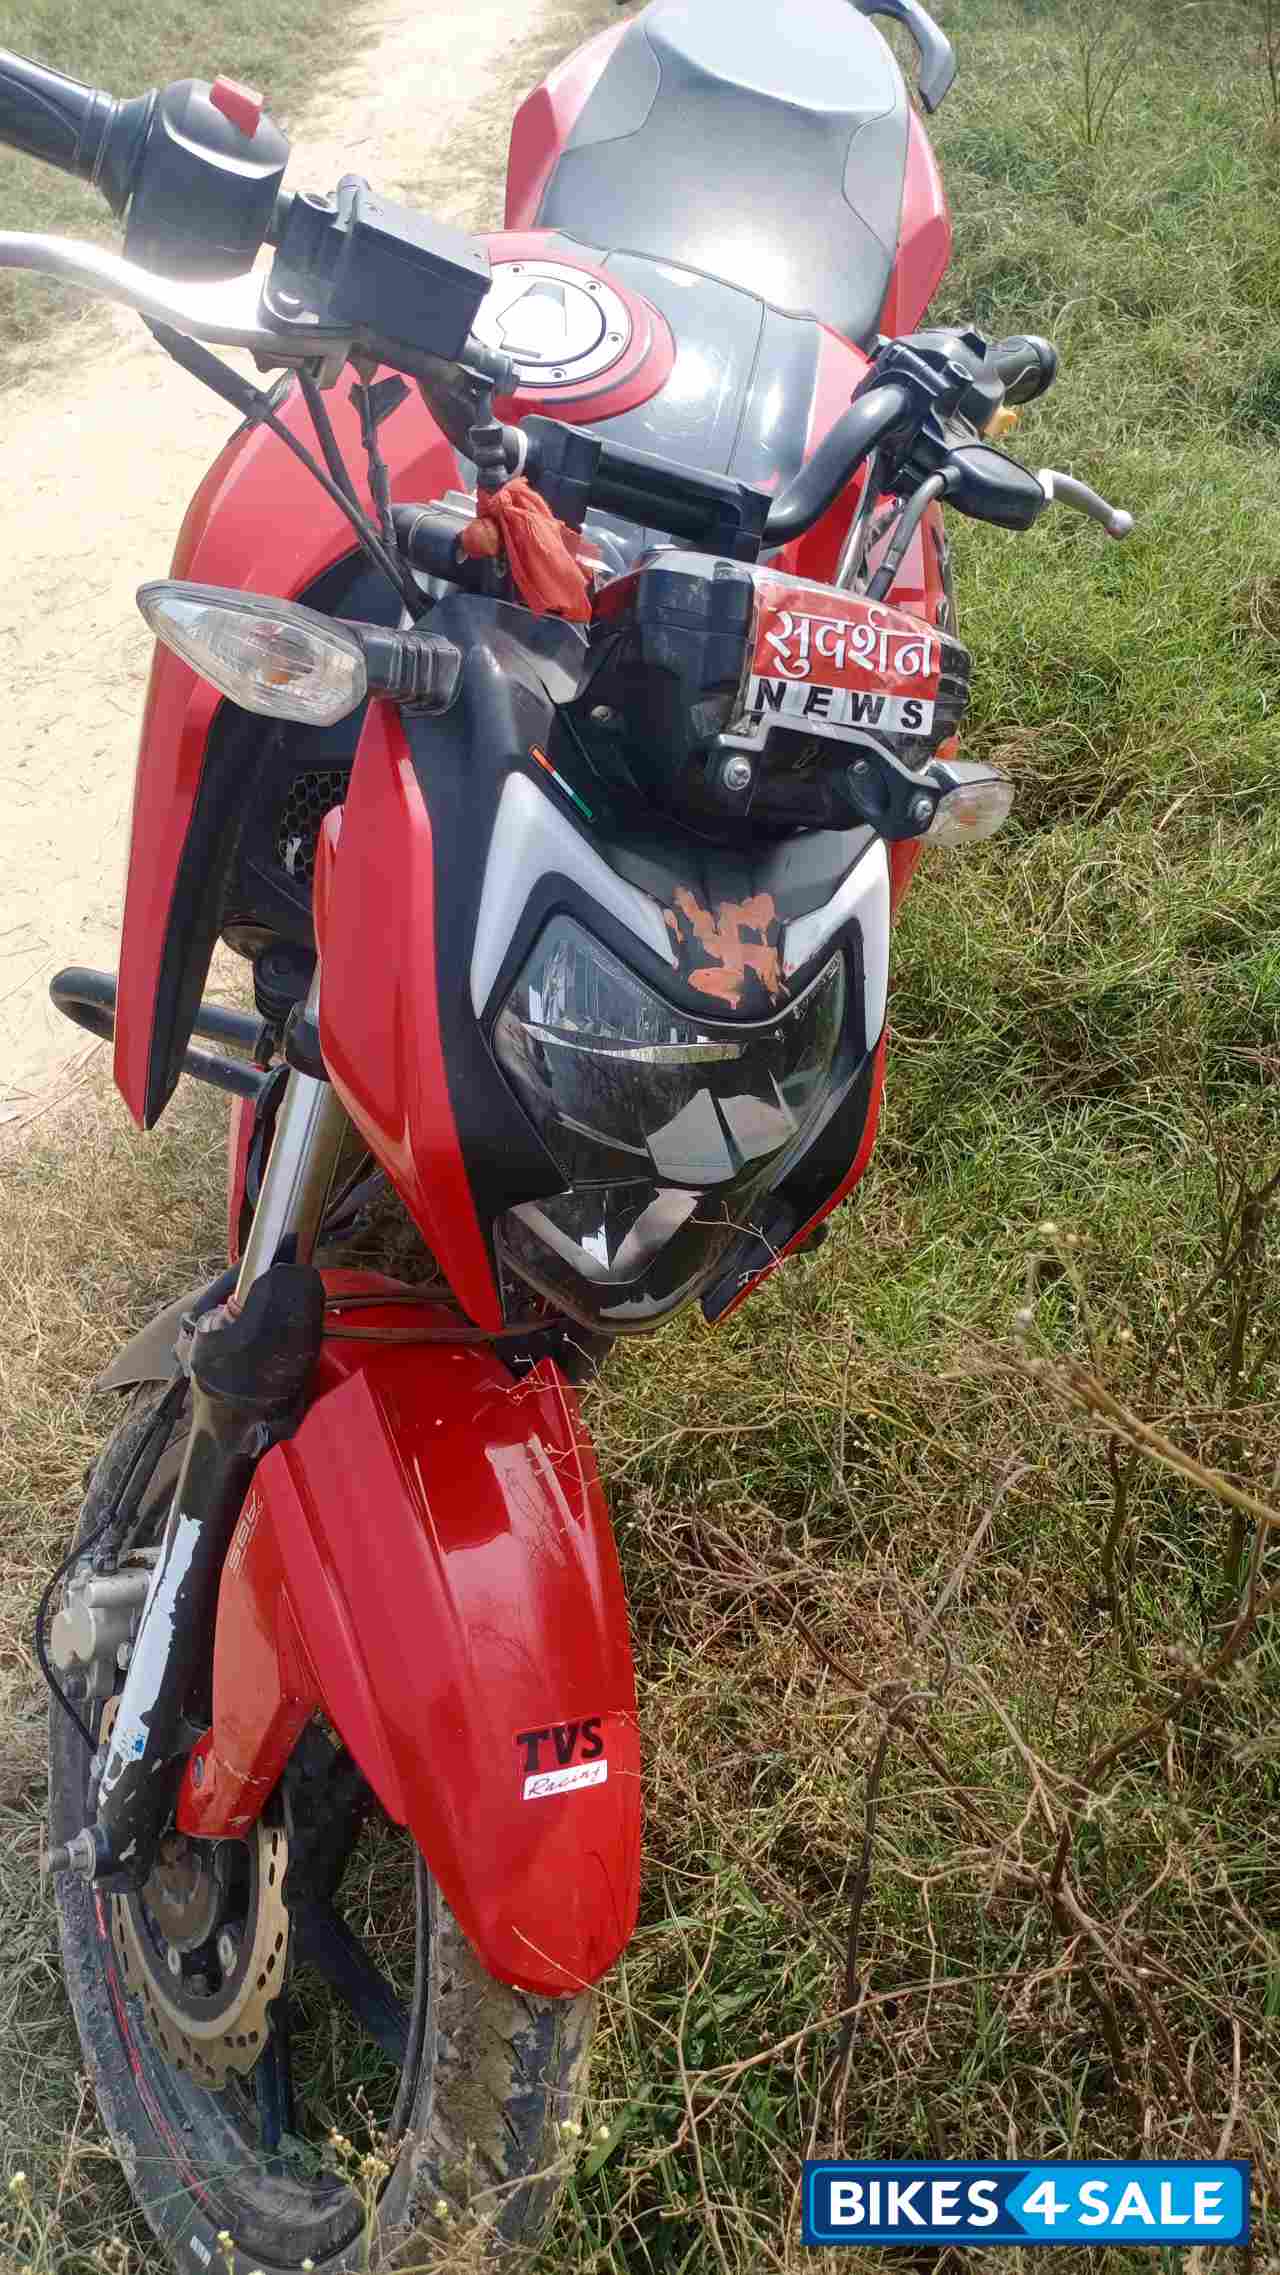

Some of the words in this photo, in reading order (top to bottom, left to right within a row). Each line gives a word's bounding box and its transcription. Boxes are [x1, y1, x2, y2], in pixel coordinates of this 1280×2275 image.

[765, 607, 933, 679] सुदर्शन
[754, 678, 923, 730] NEWS
[516, 1717, 604, 1772] TVS
